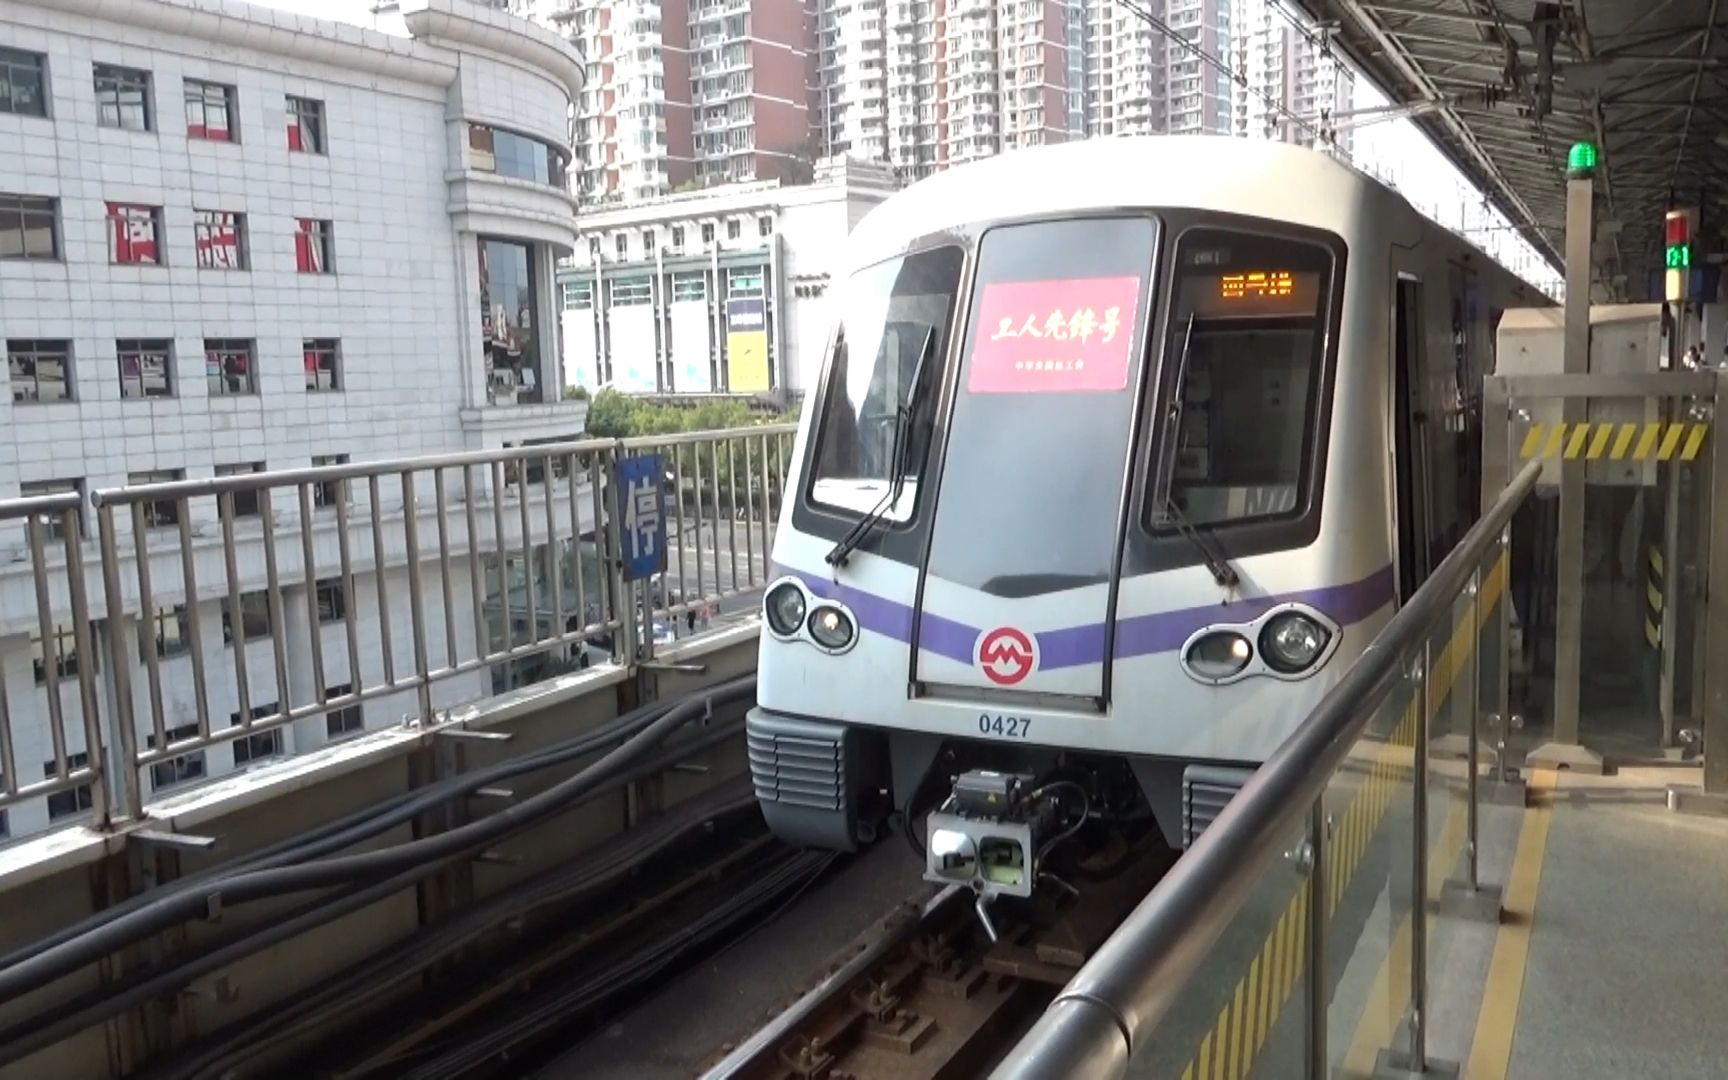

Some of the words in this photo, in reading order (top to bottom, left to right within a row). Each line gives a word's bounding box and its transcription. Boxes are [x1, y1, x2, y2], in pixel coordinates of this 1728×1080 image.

[990, 305, 1121, 344] 工人先锋号
[625, 476, 659, 559] 停
[979, 713, 1031, 738] 0427
